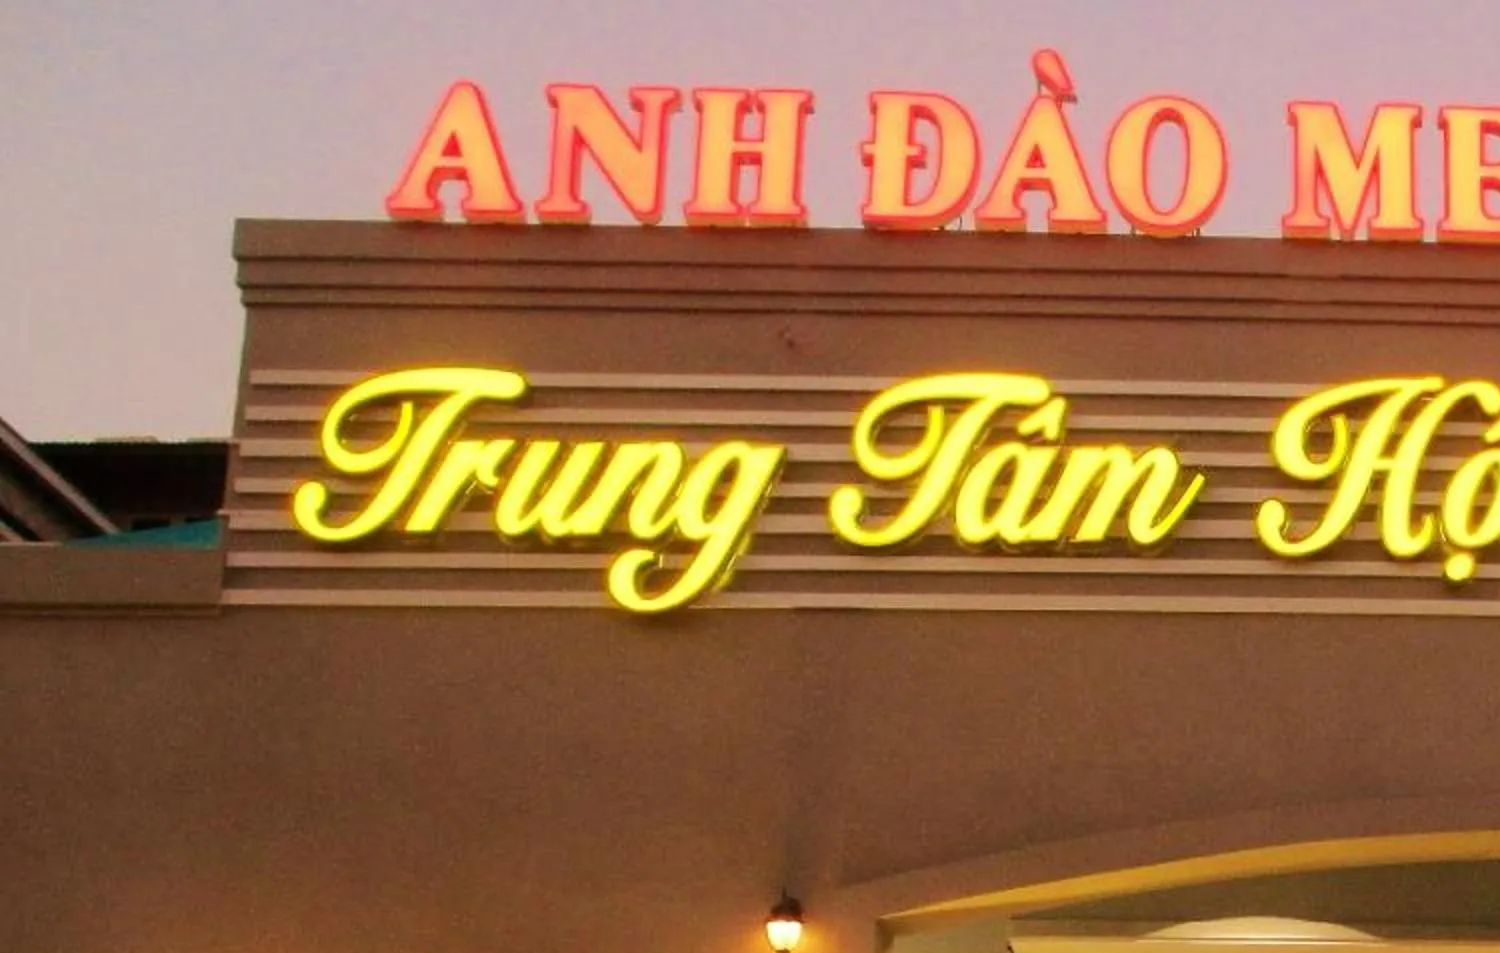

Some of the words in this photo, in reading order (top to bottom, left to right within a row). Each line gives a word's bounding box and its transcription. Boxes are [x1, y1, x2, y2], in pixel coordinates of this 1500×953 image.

[382, 78, 818, 228] ANH
[855, 47, 1232, 234] ĐÀO
[290, 365, 788, 614] Trung
[827, 371, 1206, 547] Tâm
